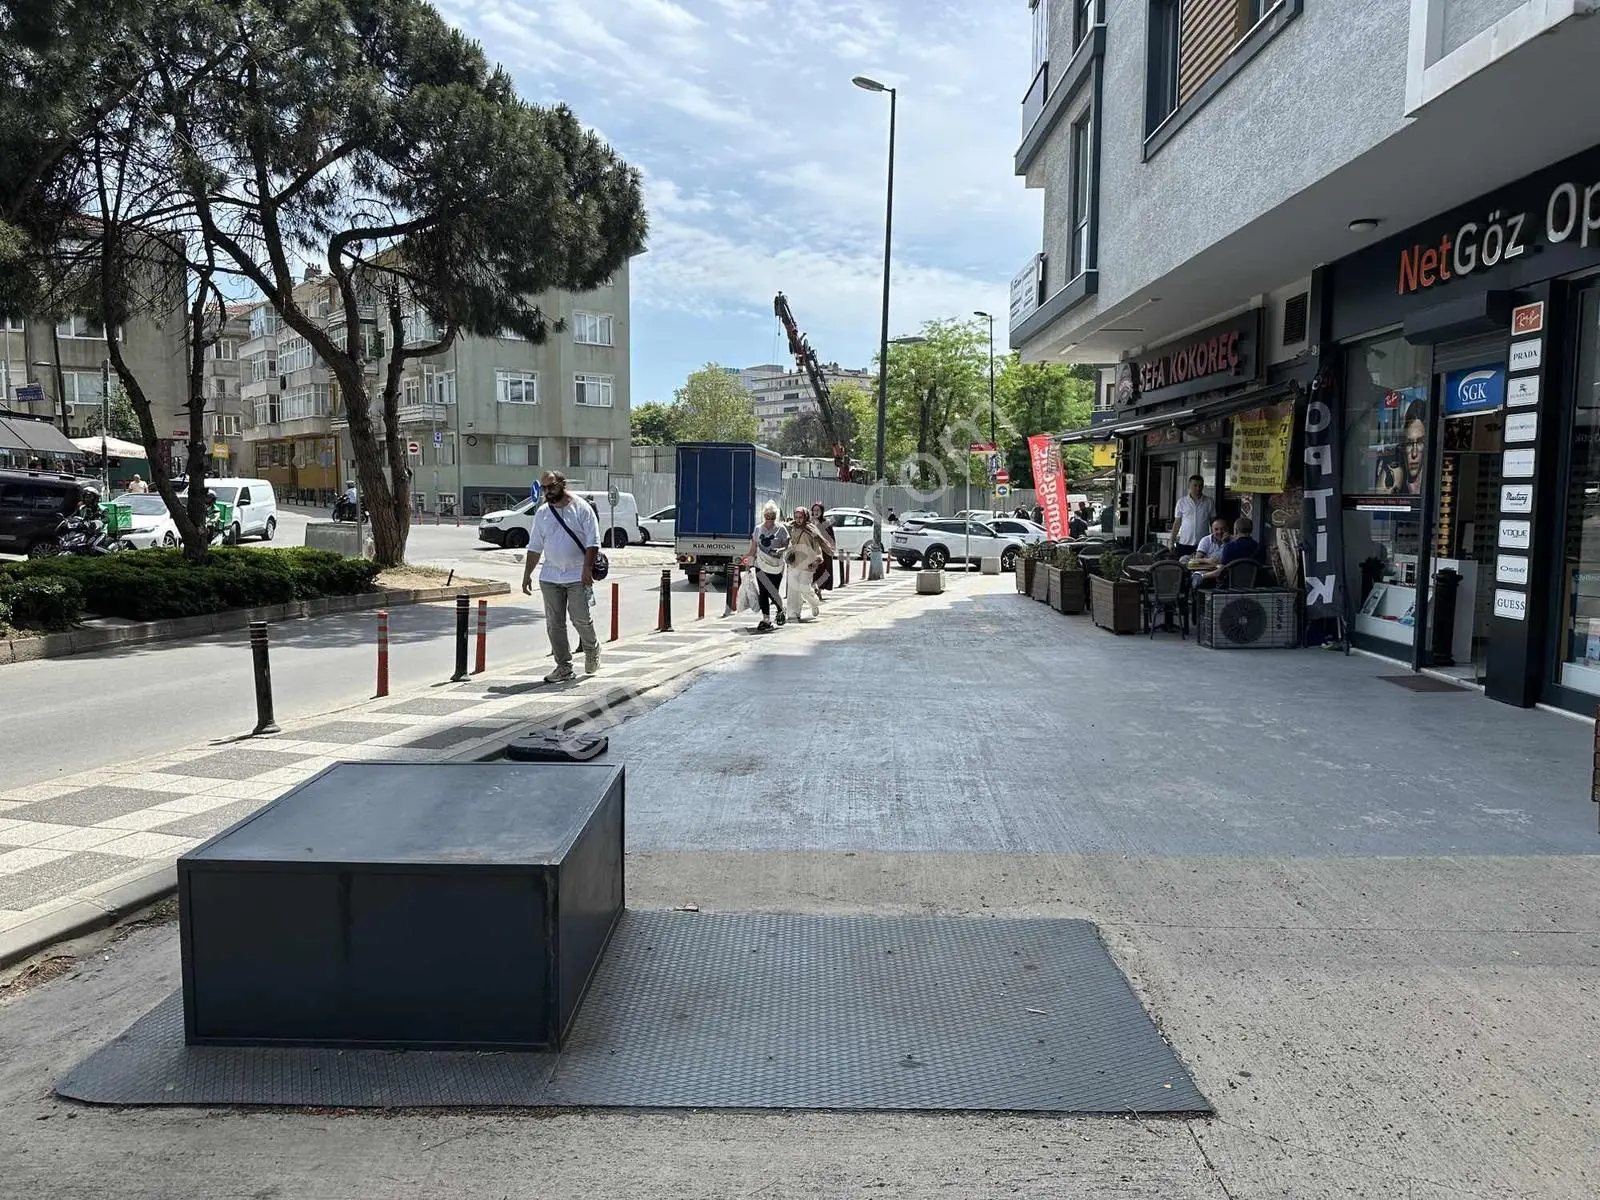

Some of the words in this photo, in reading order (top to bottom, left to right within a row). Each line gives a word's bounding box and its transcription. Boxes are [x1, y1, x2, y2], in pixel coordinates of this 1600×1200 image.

[1398, 209, 1526, 296] NetGöz
[1139, 355, 1166, 393] SEFA
[1169, 329, 1240, 385] KOKOREÇ
[1513, 350, 1538, 361] PRADA
[1462, 381, 1488, 402] SGK
[1502, 529, 1528, 538] VOGUE
[1497, 597, 1526, 611] GUESS
